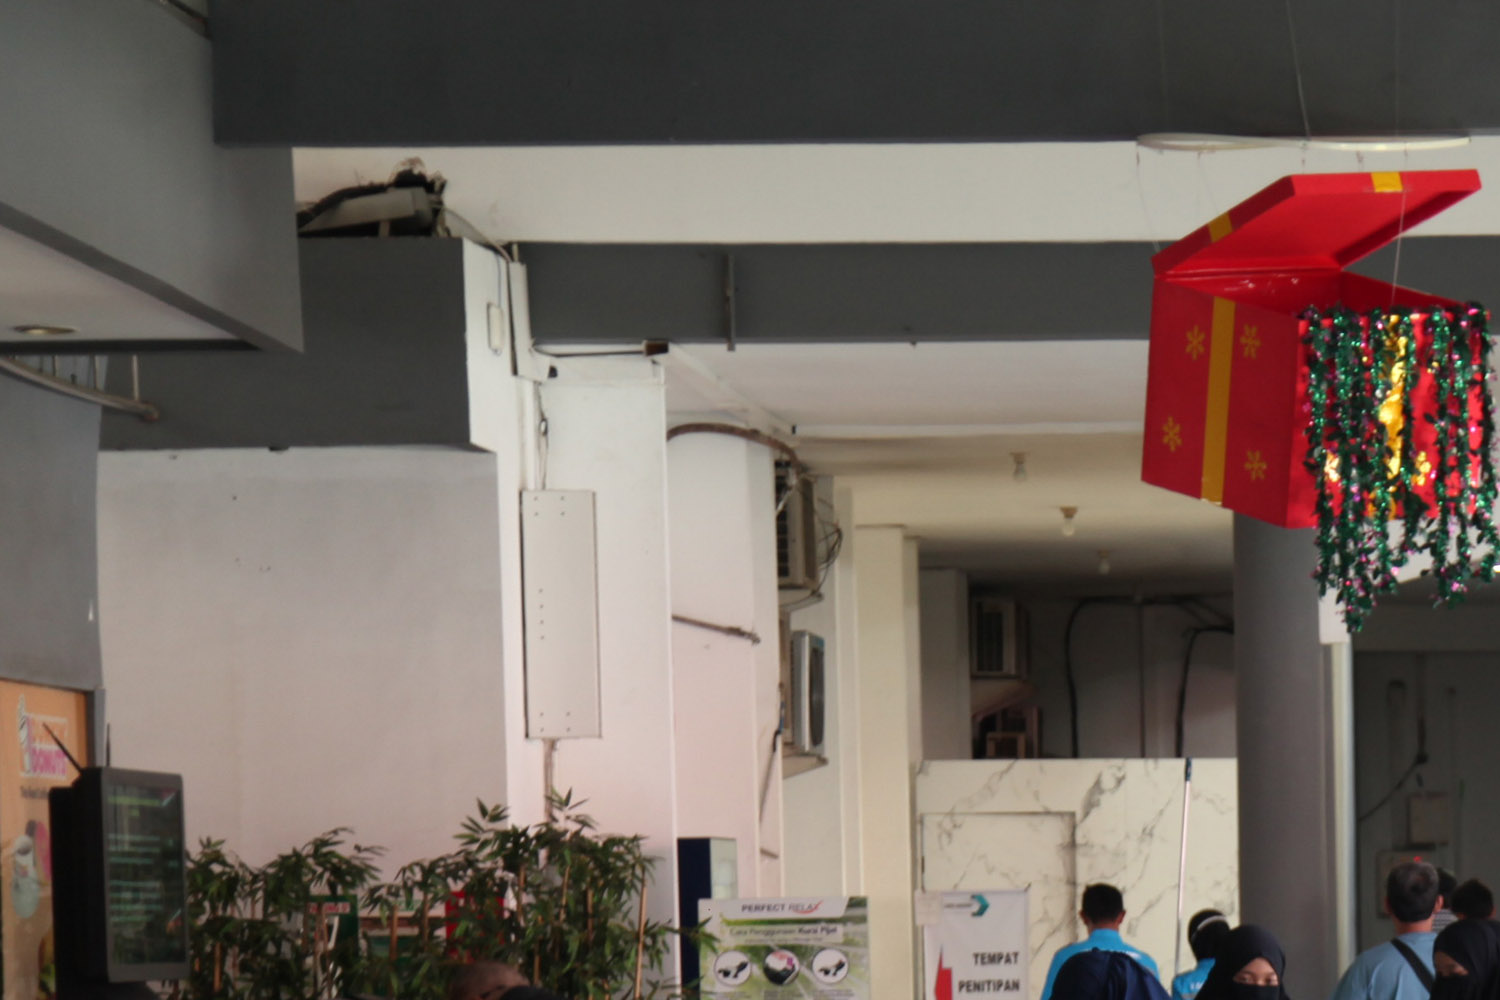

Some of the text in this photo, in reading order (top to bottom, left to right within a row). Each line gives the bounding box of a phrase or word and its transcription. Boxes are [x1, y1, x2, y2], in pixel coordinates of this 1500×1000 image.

[741, 903, 786, 912] PERFECT
[972, 952, 1019, 966] TEMPAT
[958, 979, 1020, 992] PENITIPAN
